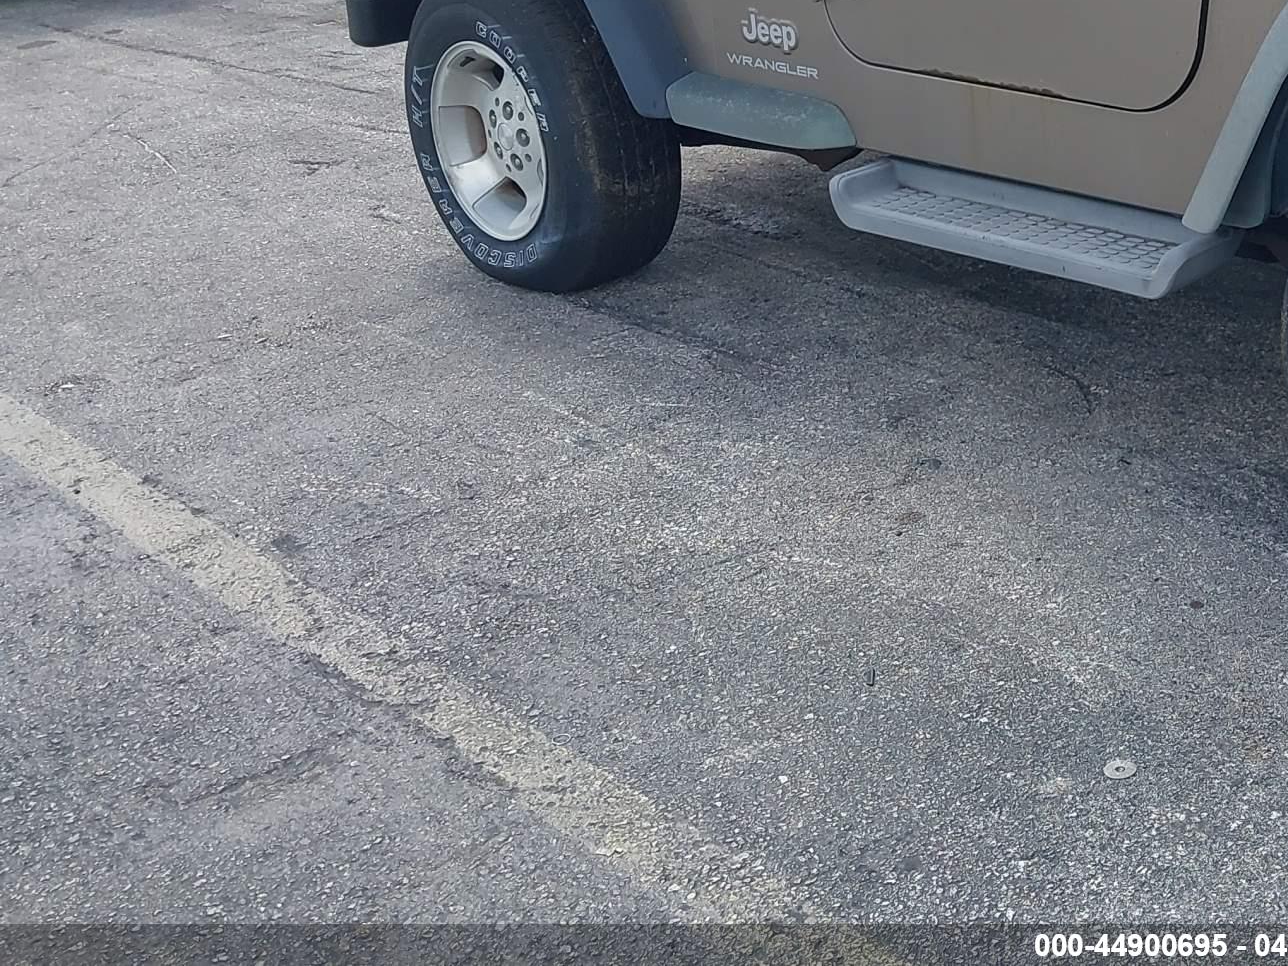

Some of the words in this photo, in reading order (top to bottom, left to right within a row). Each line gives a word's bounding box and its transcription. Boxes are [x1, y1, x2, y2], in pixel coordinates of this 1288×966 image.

[726, 52, 819, 80] WRANGLER
[741, 8, 797, 53] Jeep
[475, 21, 549, 132] COOPER
[420, 153, 538, 268] DISCOVERER
